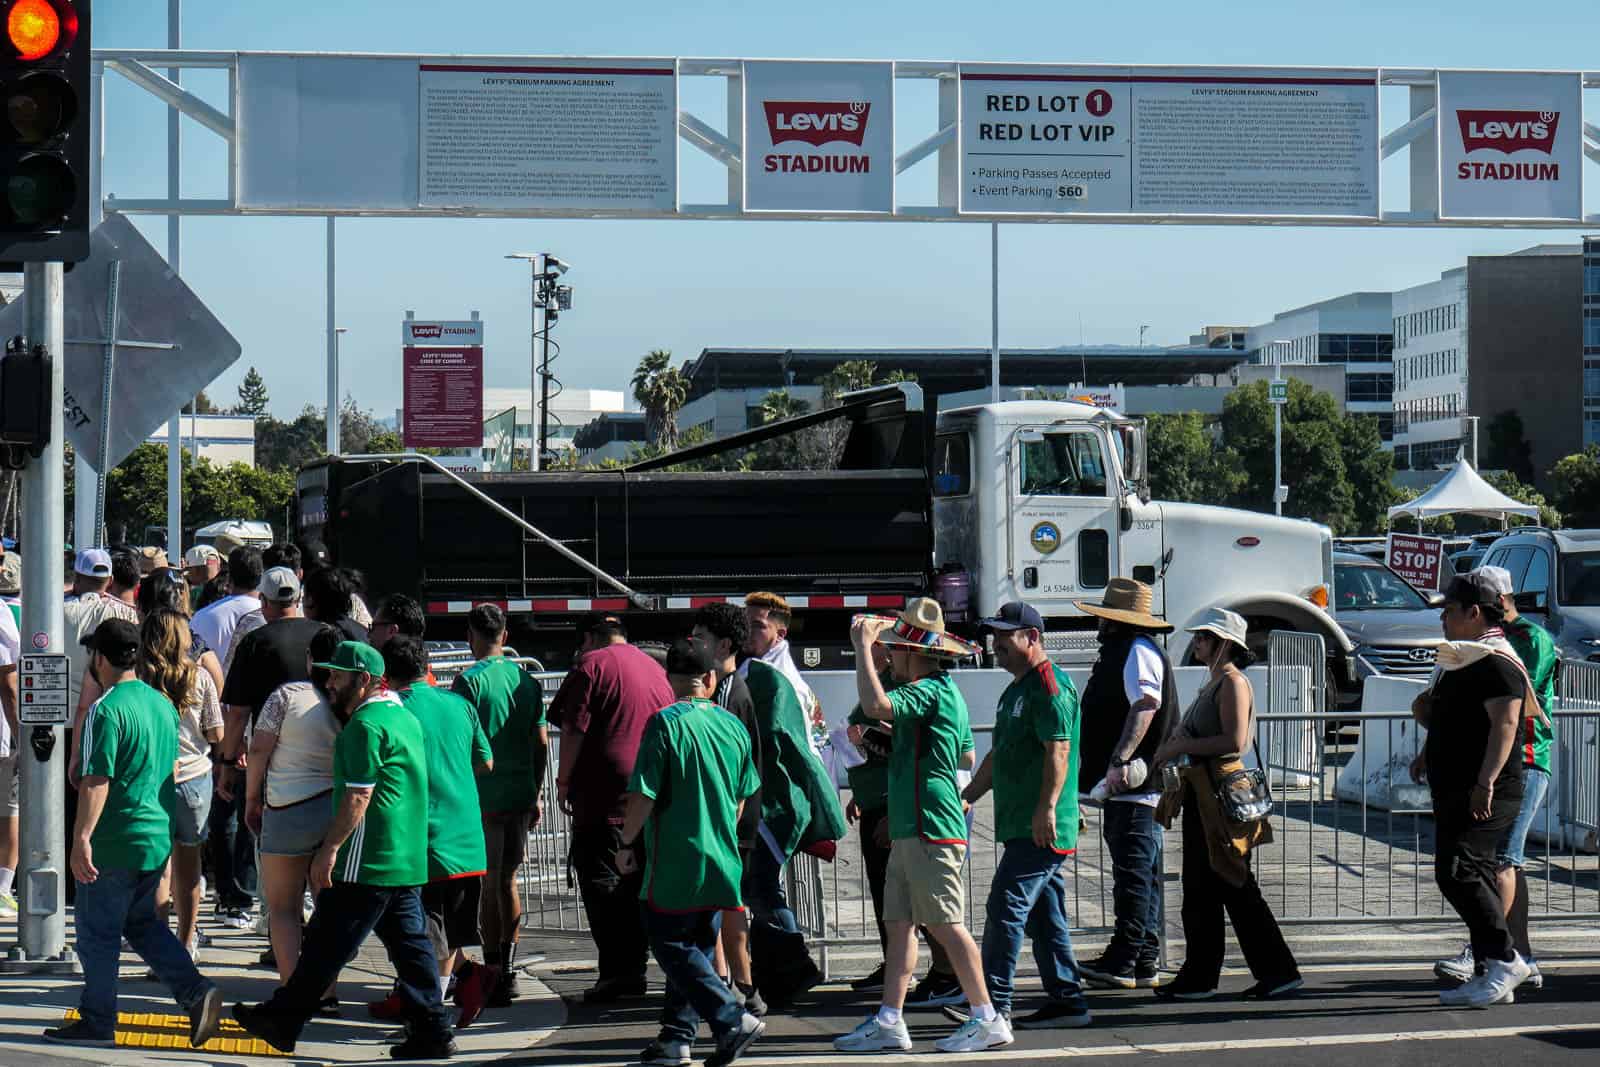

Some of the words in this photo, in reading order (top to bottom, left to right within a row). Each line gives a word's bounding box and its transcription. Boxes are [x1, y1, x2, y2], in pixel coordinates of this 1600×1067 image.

[573, 80, 615, 88] AGREEMENT
[1216, 88, 1247, 97] STADIUM
[1247, 88, 1277, 97] PARKING
[1277, 89, 1318, 97] AGREEMENT
[986, 94, 1030, 112] RED
[1037, 95, 1080, 113] LOT
[979, 123, 1023, 141] RED
[1030, 124, 1073, 142] LOT
[1078, 125, 1115, 142] VIP
[764, 155, 870, 173] STADIUM
[979, 167, 1020, 179] Parking
[1022, 168, 1058, 178] Passes
[1061, 169, 1111, 181] Accepted
[1457, 162, 1559, 181] STADIUM
[979, 185, 1008, 196] Event
[1012, 185, 1053, 198] Parking
[1057, 186, 1083, 198] $60
[444, 327, 476, 335] STADIUM
[1393, 540, 1419, 549] WRONG
[1424, 543, 1439, 551] WAY
[1392, 551, 1437, 570] STOP
